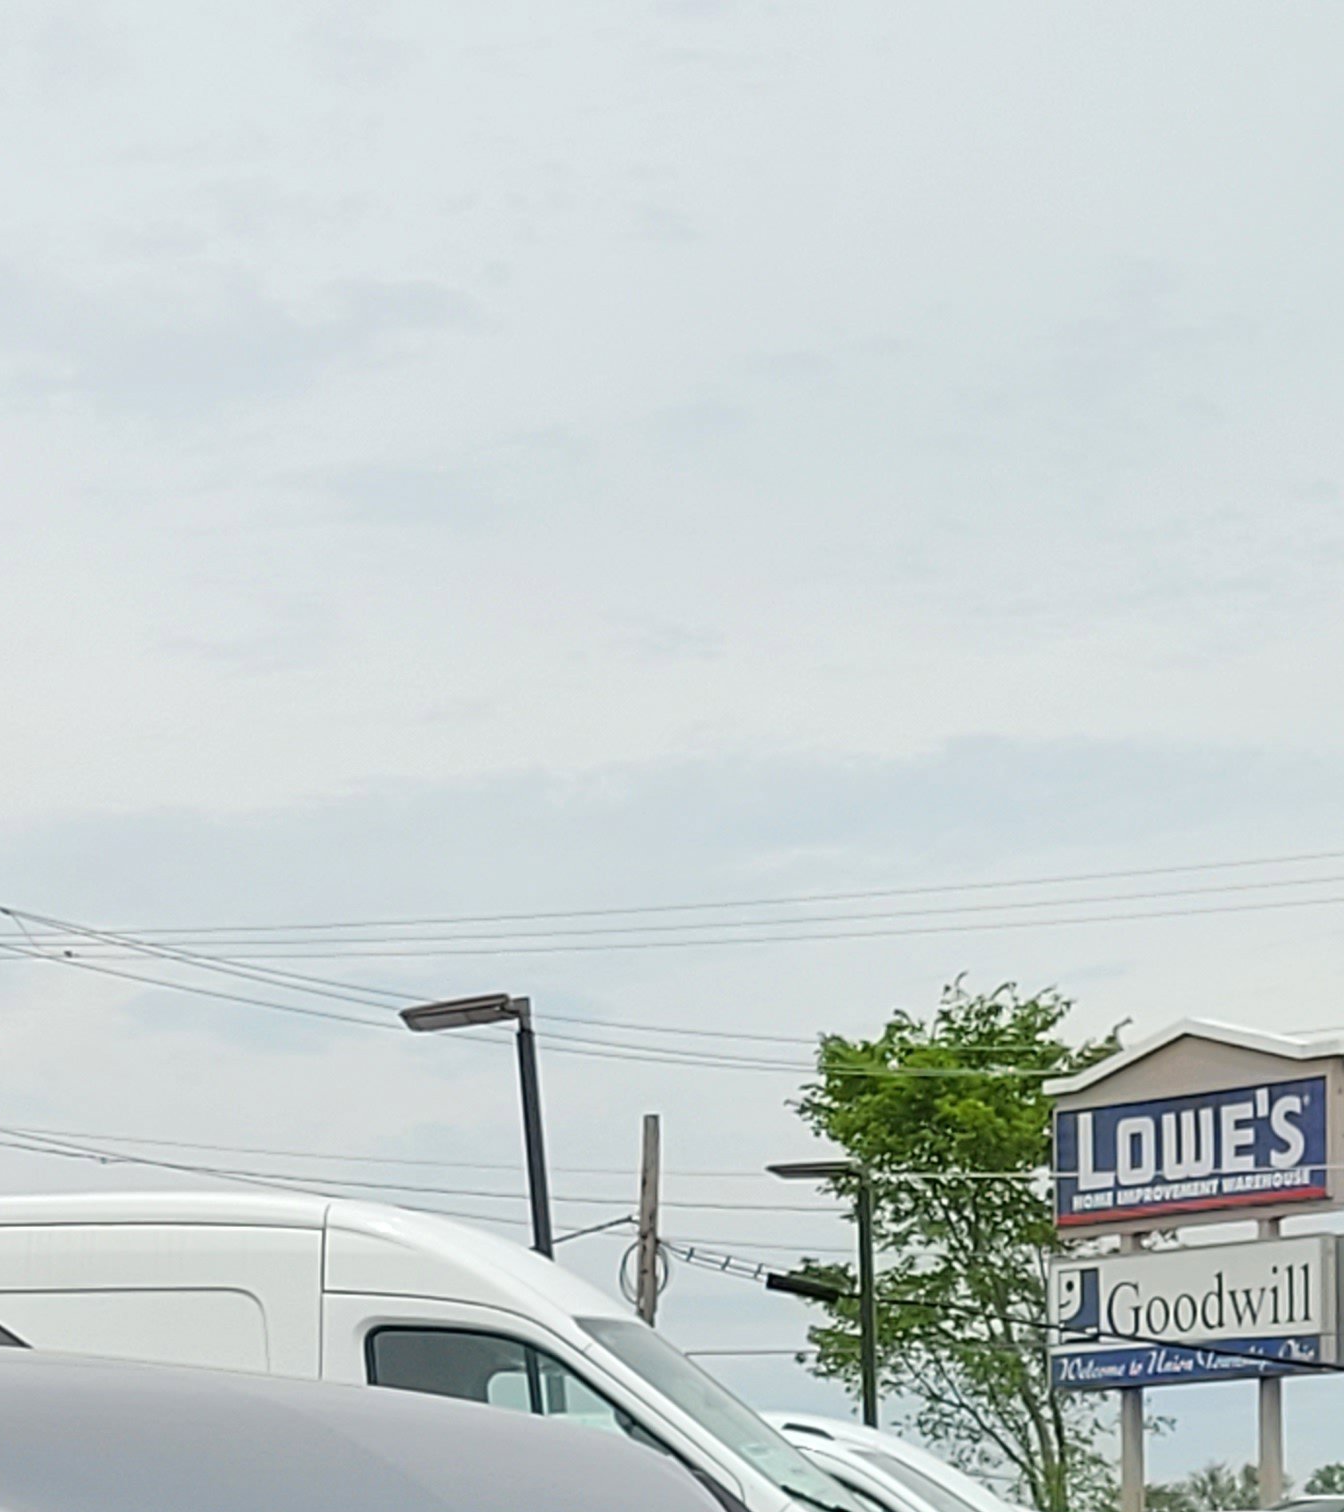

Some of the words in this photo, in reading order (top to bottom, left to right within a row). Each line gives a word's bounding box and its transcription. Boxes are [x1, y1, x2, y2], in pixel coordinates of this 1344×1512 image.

[1076, 1087, 1305, 1191] LOWE'S
[1072, 1191, 1112, 1212] HOME
[1116, 1179, 1220, 1206] IMPROVEMENT
[1221, 1168, 1311, 1193] WAREHOUSE
[1106, 1263, 1312, 1338] Goodwill
[1059, 1356, 1125, 1381] Welcome
[1129, 1359, 1143, 1376] to
